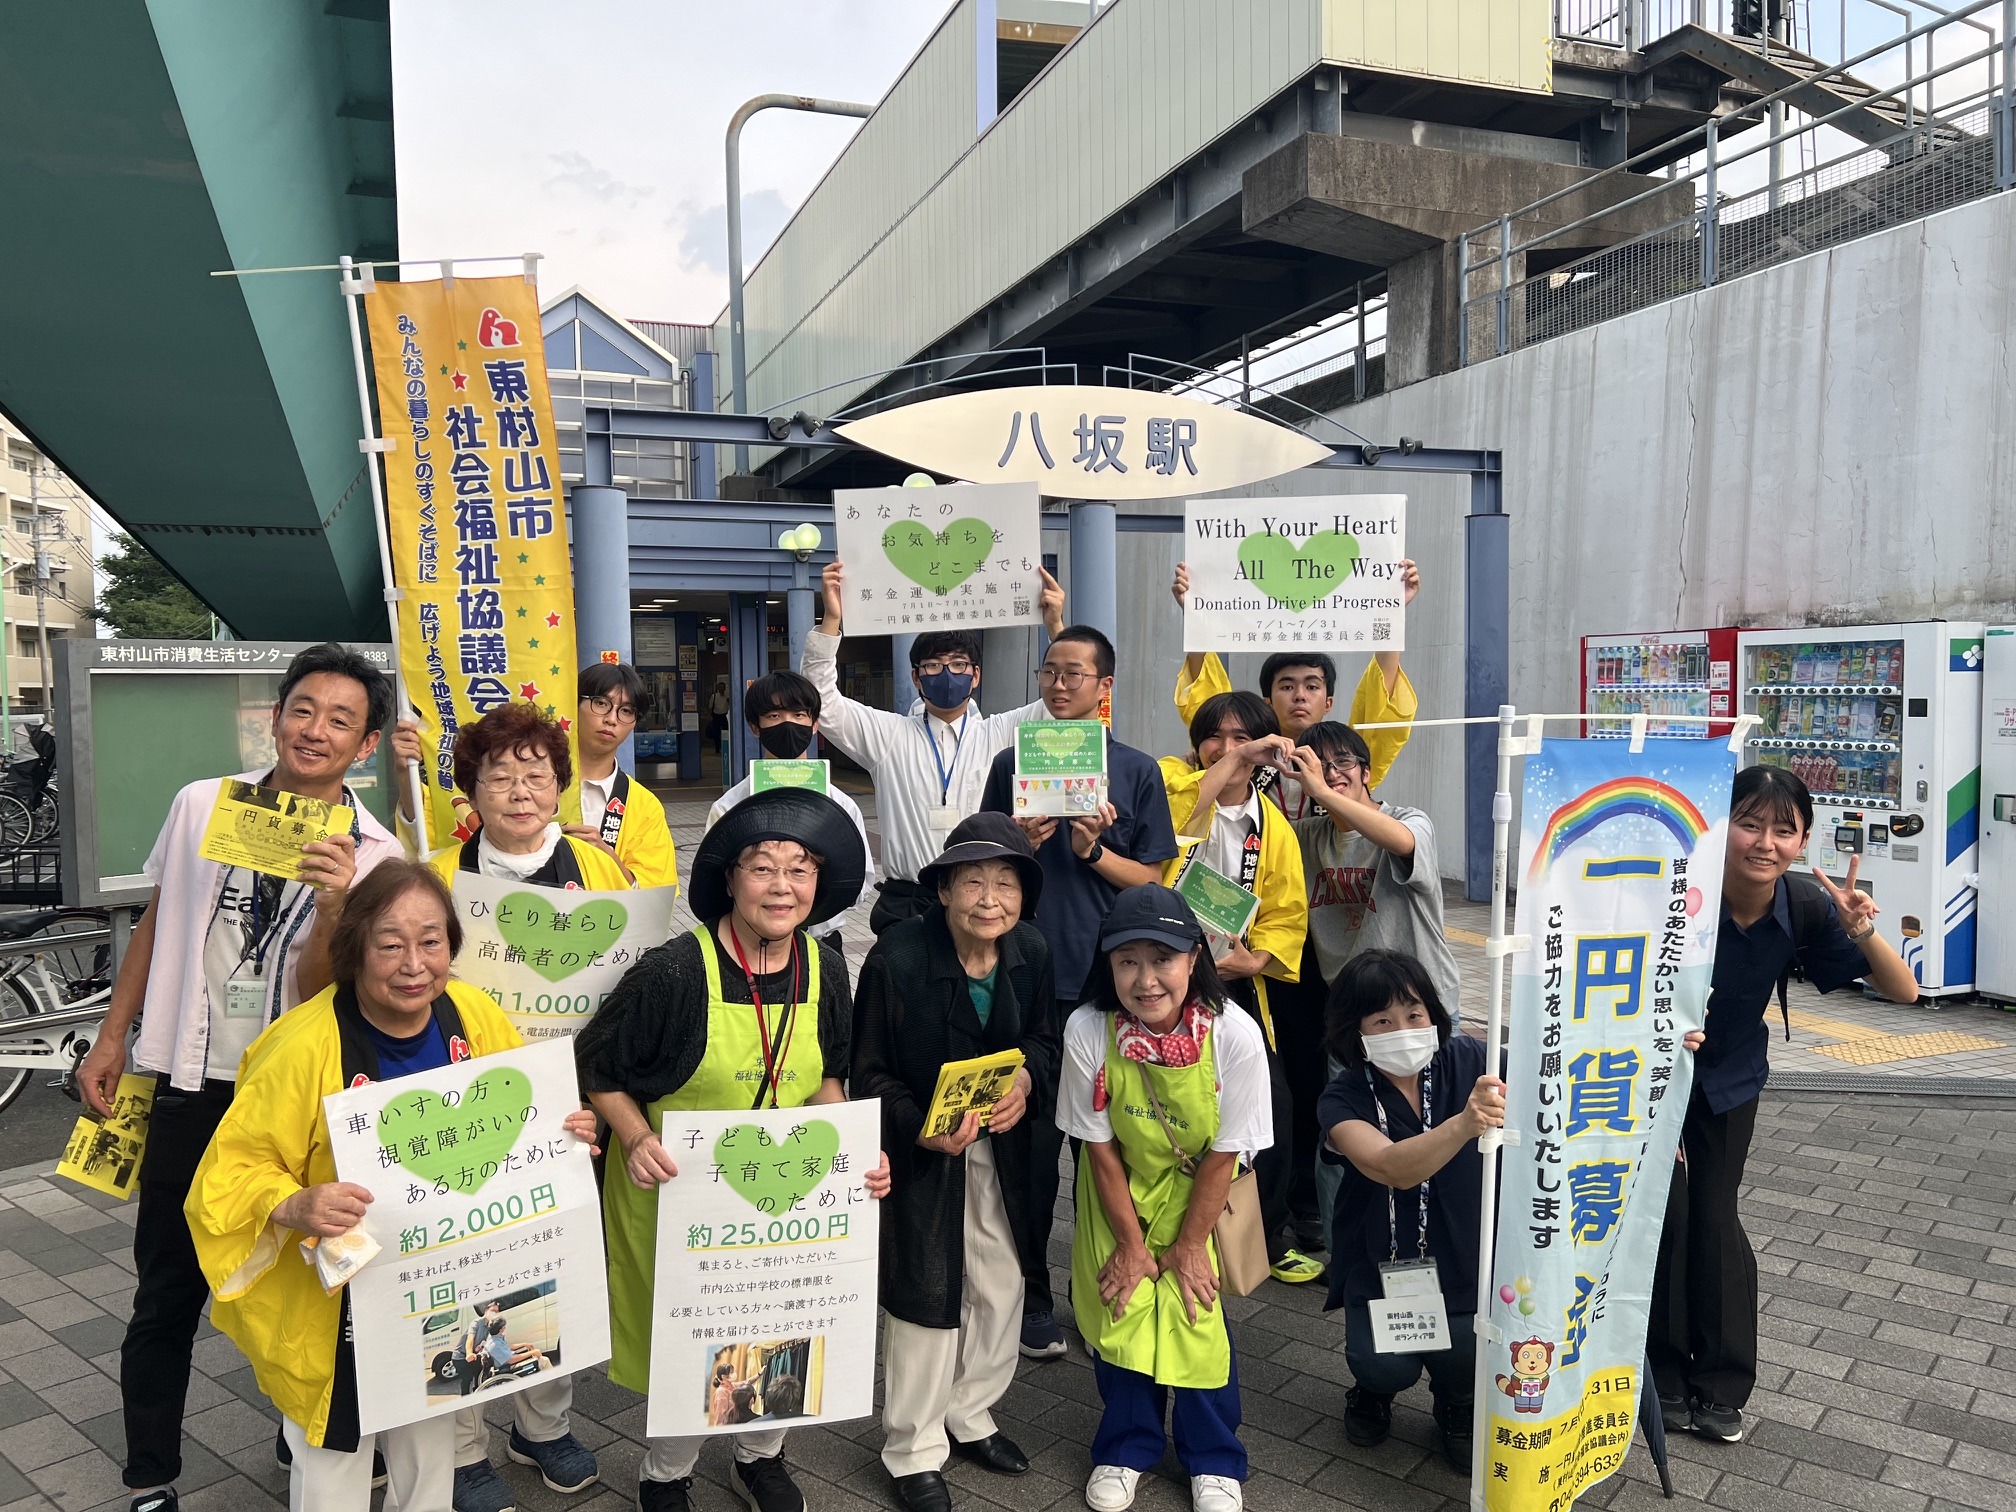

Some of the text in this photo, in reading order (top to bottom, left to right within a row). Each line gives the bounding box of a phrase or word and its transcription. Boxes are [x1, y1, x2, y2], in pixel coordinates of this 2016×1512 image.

[397, 313, 439, 583] みんなの暮らしのすぐそばに
[484, 359, 553, 539] 東村山市
[998, 410, 1198, 476] 八坂駅
[847, 503, 953, 520] あなたの
[882, 529, 1004, 548] お気持ちを
[1196, 515, 1398, 539] With Your Heart
[445, 404, 514, 714] 社会福祉協議会
[929, 557, 1032, 576] どこまでも
[1234, 557, 1398, 581] All The Way
[860, 581, 1022, 602] 募金運動実施中
[1194, 594, 1400, 611] Donation Drive in Progress
[874, 608, 1008, 625] 一円貨募金推進委員会
[1217, 630, 1365, 642] 一円貨募金推進委員会
[100, 645, 296, 663] 東村山市消費生活センター
[469, 899, 623, 932] ひとり暮らし
[480, 987, 608, 1014] 約1,000
[1529, 904, 1562, 1250] ご協力をお願いいたします
[376, 1105, 539, 1169] 視覚障がいの
[682, 1123, 808, 1150] 子どもや
[406, 1138, 567, 1205] ある方のために
[706, 1153, 850, 1183] 子育て家庭
[756, 1186, 865, 1213] のために
[399, 1183, 557, 1254] 約2,000円
[687, 1213, 850, 1249] 約25,000円
[398, 1225, 566, 1285] 集まれば、移送サービス支援を
[698, 1250, 838, 1272] 集まると、ご寄付いただいた
[700, 1274, 834, 1295] 市内公立中学校の標準服を
[669, 1292, 860, 1318] 必要としている方々へ譲渡するための
[691, 1316, 838, 1340] 情報を届けることができます
[1496, 1426, 1552, 1451] 募金期間
